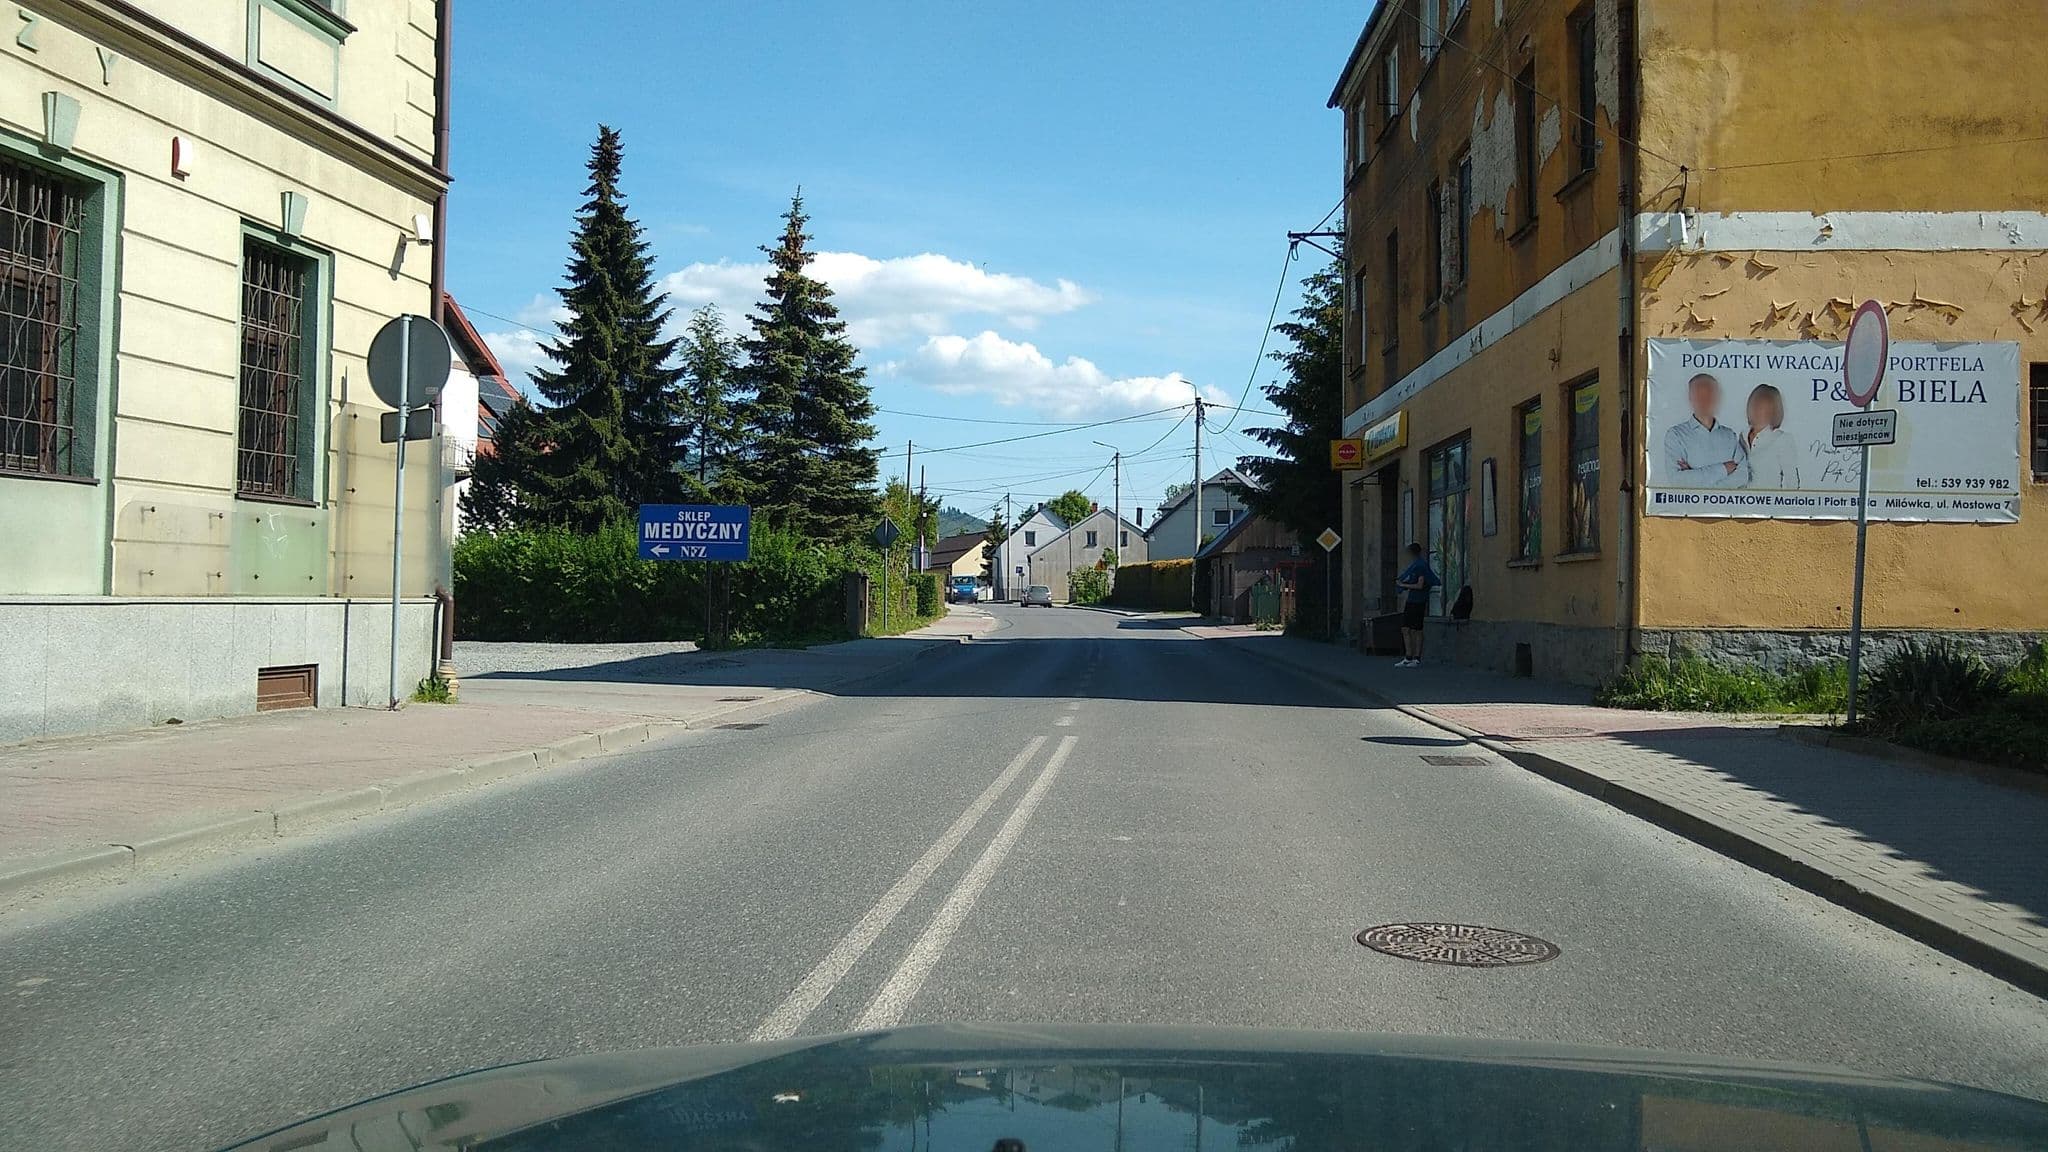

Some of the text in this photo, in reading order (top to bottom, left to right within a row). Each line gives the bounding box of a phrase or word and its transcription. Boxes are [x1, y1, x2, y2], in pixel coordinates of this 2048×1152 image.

[1682, 354, 1984, 373] PODATKI WRACAJ PORTFELA
[1898, 380, 1987, 403] BIELA
[1840, 417, 1888, 428] Nie dotyczy
[1916, 478, 2009, 489] tel.: 539 939 982
[1668, 494, 1700, 504] BIURO
[1703, 495, 1771, 505] PODATKOWE
[1774, 496, 1815, 506] Mariola
[1824, 497, 1847, 506] Piotr
[1851, 497, 1876, 507] Bila
[1885, 498, 1934, 510] Milówka,
[1937, 499, 1948, 509] ul.
[1952, 499, 2000, 510] Mostowa
[2004, 500, 2011, 510] 7
[678, 511, 711, 521] SKLEP
[644, 522, 743, 540] MEDYCZNY
[681, 546, 707, 558] NFZ
